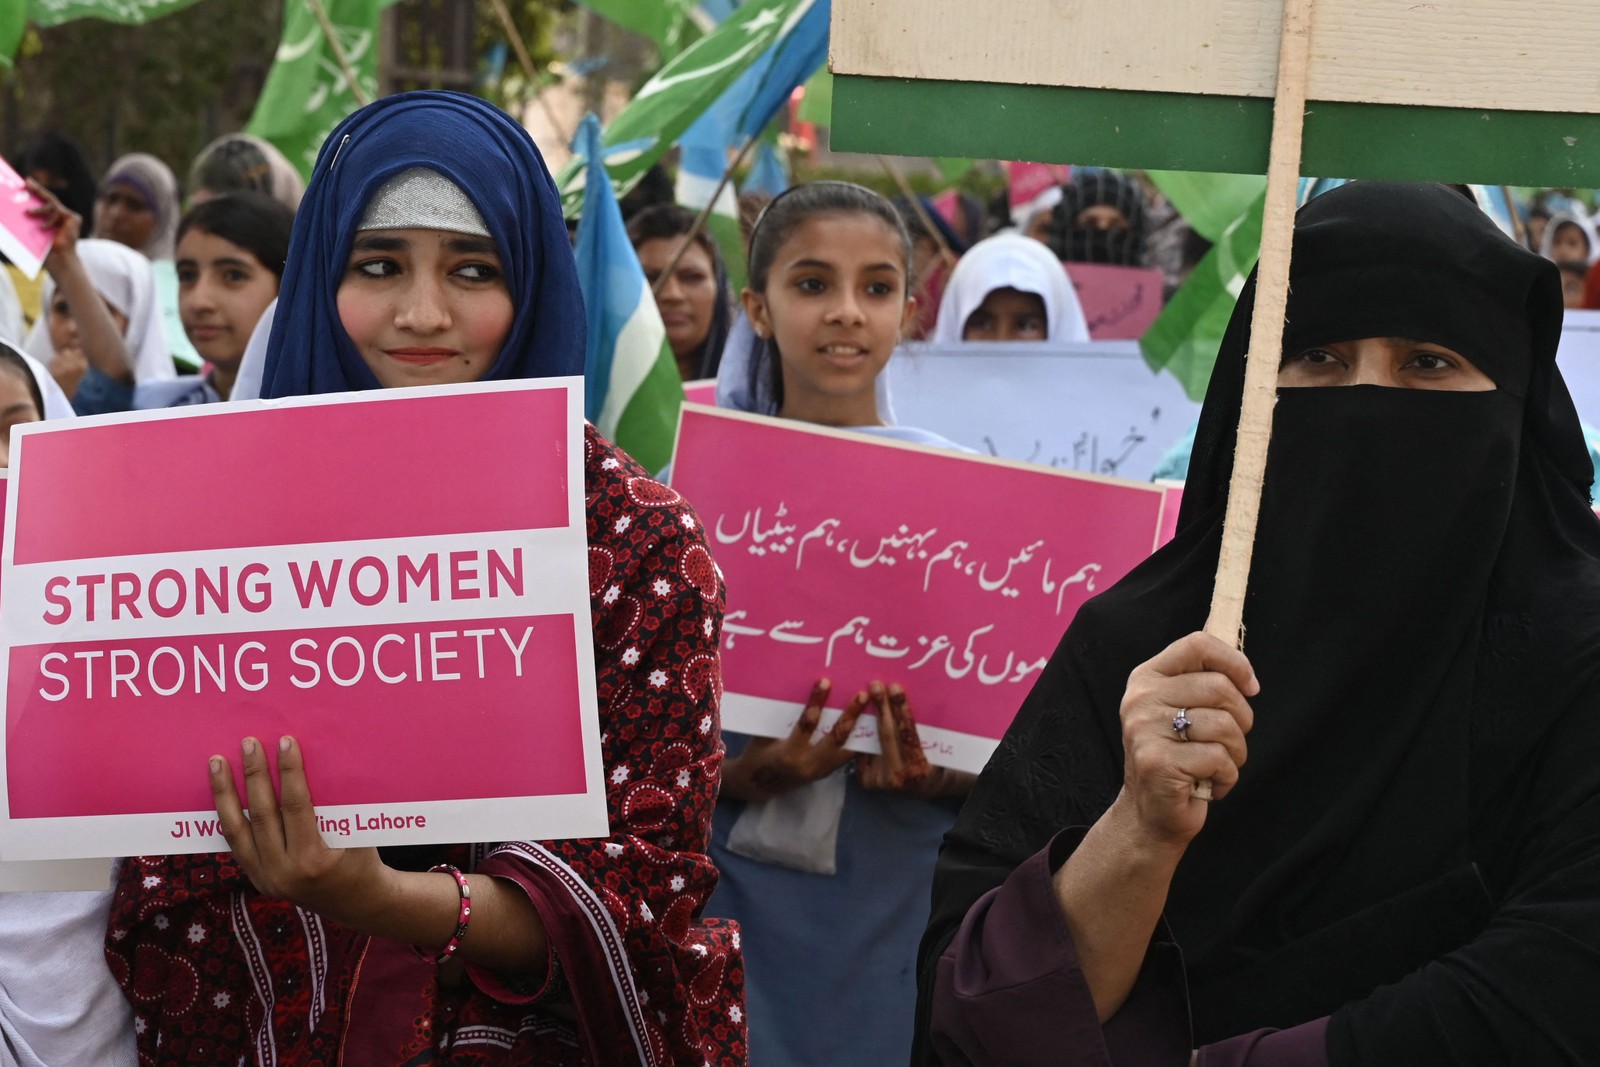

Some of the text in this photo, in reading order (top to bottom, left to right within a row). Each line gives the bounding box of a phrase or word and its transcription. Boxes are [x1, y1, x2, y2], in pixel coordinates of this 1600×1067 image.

[715, 501, 797, 557] بیٹیاں
[796, 518, 841, 570] ہم
[42, 547, 525, 625] STRONG WOMEN
[923, 540, 969, 593] ہم
[1056, 562, 1102, 616] ہم
[722, 610, 766, 650] ہے
[768, 620, 825, 645] سے
[825, 616, 871, 668] ہم
[865, 634, 951, 670] عزت
[944, 623, 995, 680] کی
[38, 626, 534, 702] STRONG SOCIETY
[170, 820, 191, 838] JI
[315, 815, 351, 836] ing
[355, 812, 427, 831] Lahore
